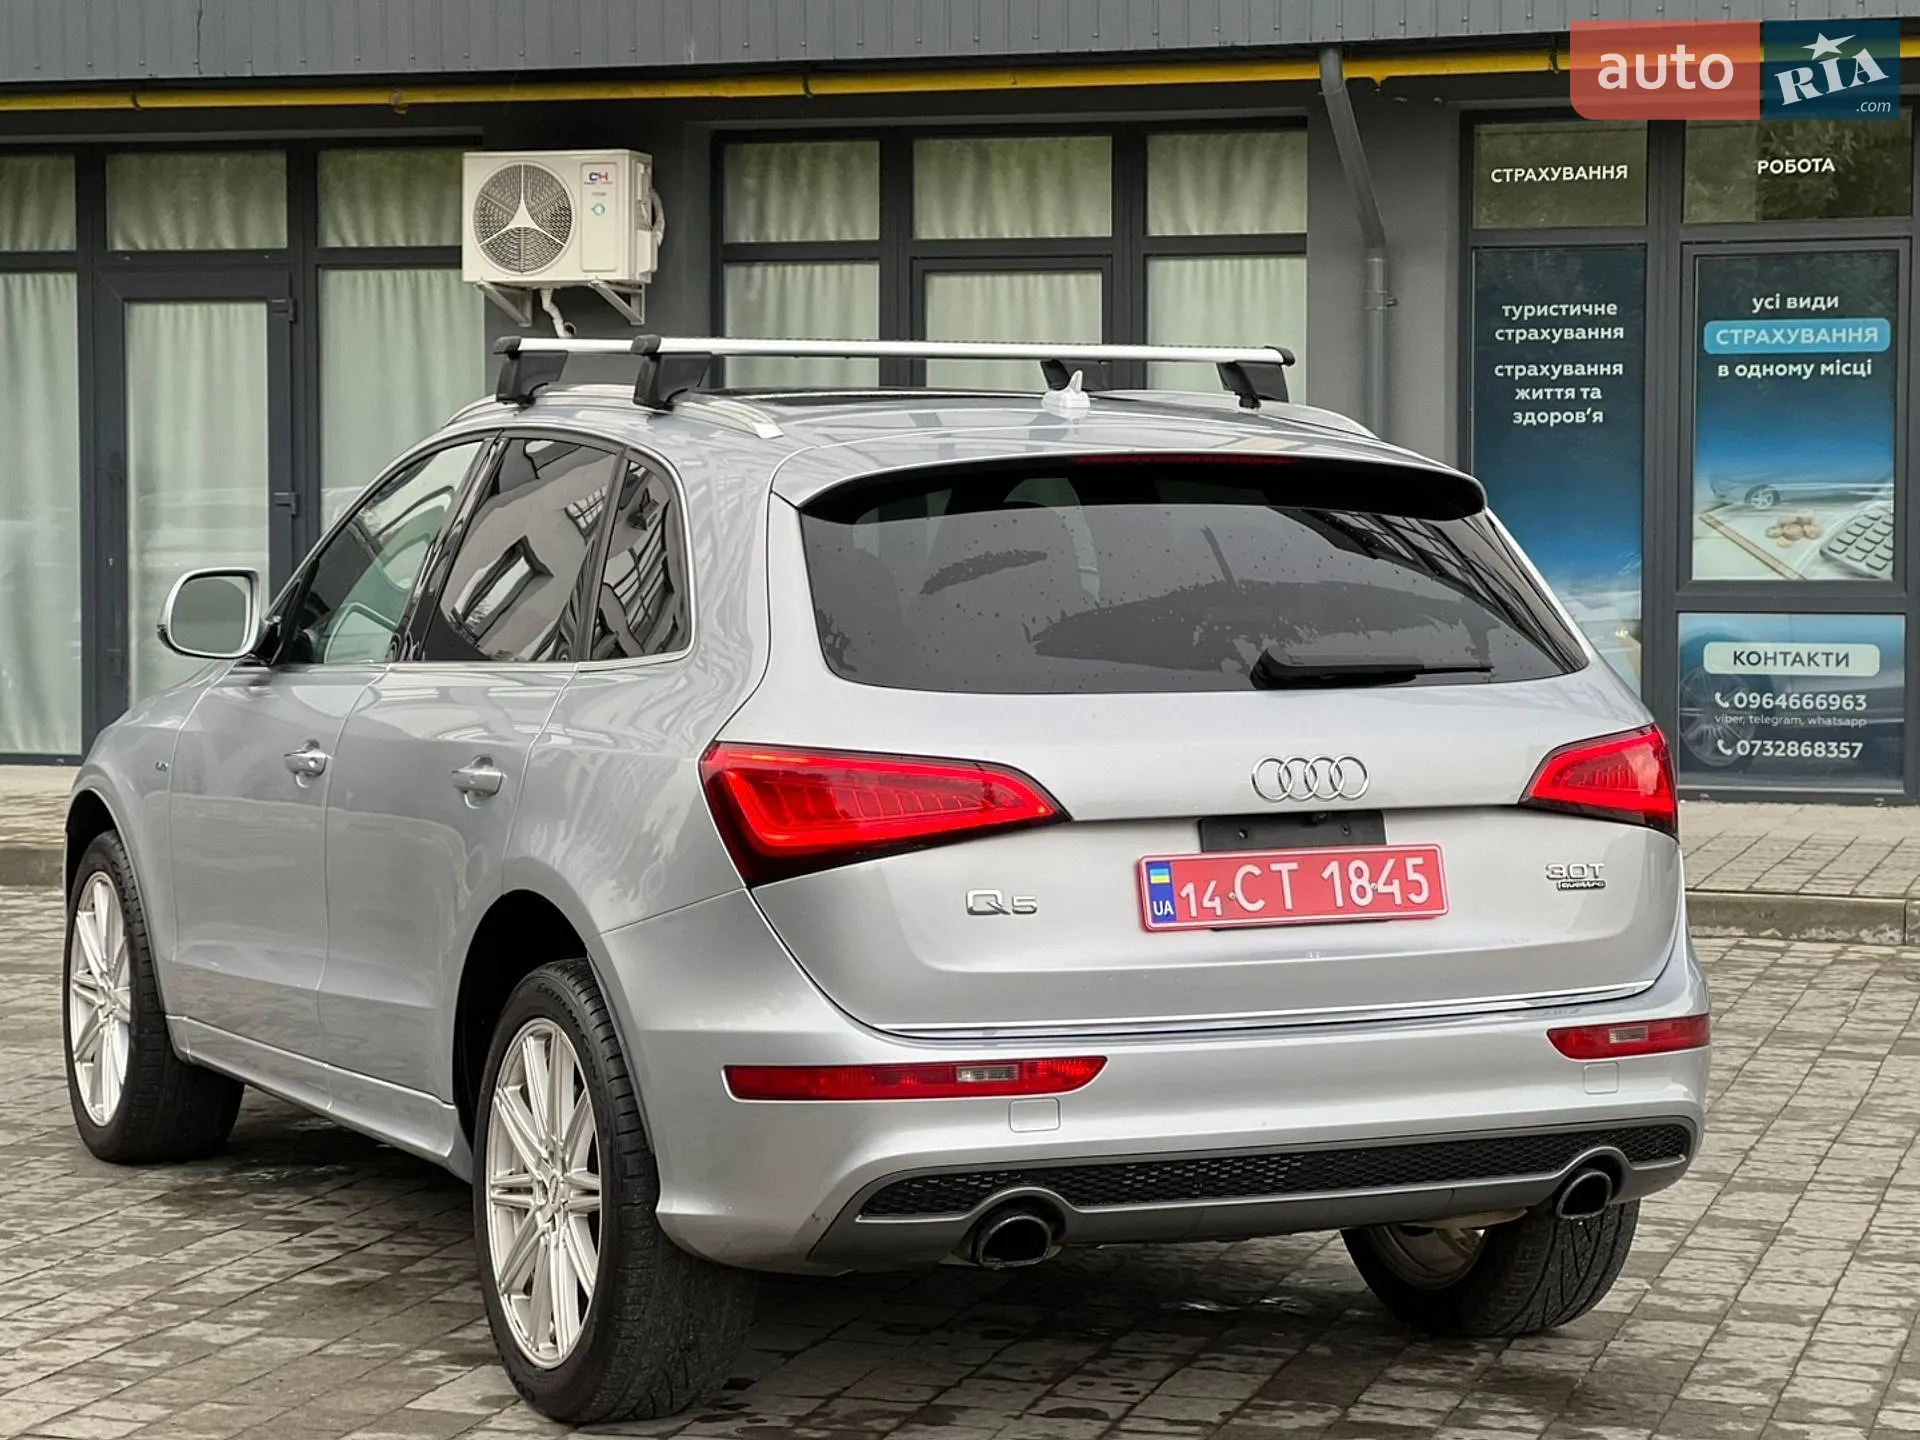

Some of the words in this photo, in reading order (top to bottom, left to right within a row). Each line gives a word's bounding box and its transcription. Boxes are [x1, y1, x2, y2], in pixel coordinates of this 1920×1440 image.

[1490, 164, 1628, 183] СТРАХУВАННЯ
[1757, 157, 1836, 175] РОБОТА
[1501, 301, 1618, 321] туристичне
[1751, 292, 1781, 313] усі
[1786, 295, 1839, 311] види
[1494, 325, 1625, 344] страхування
[1715, 326, 1879, 346] СТРАХУВАННЯ
[1494, 361, 1624, 381] страхування
[1718, 364, 1730, 377] в
[1734, 362, 1815, 381] одному
[1820, 358, 1873, 378] місці
[1514, 386, 1576, 401] життя
[1579, 386, 1602, 400] та
[1512, 407, 1604, 427] здоров'я
[1732, 650, 1850, 668] КОНТАКТИ
[1733, 691, 1867, 711] 0964666963
[1748, 715, 1804, 727] telegram,
[1807, 716, 1867, 728] whatsapp
[1736, 739, 1864, 758] 0732868357
[1179, 880, 1222, 918] 14
[1234, 862, 1300, 912] CT
[1320, 856, 1430, 908] 1845
[965, 889, 1038, 916] Q5
[1152, 899, 1174, 917] UA
